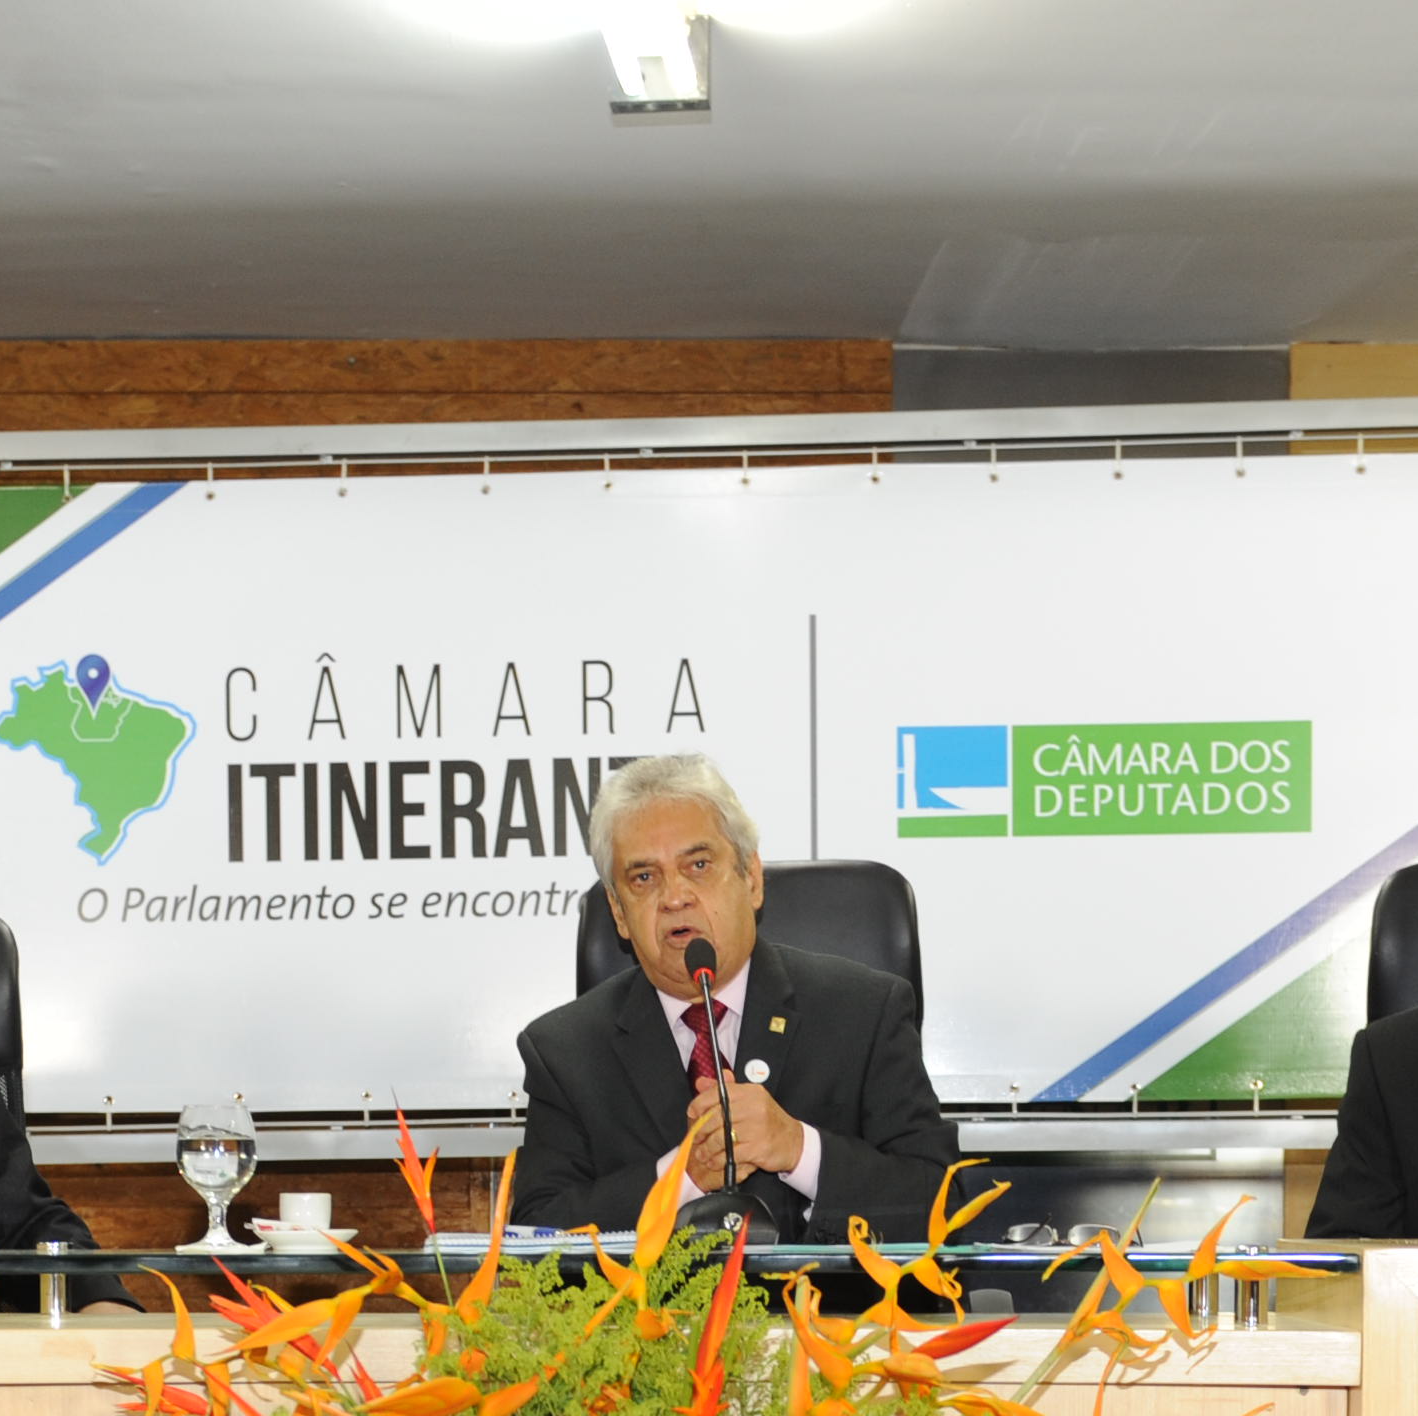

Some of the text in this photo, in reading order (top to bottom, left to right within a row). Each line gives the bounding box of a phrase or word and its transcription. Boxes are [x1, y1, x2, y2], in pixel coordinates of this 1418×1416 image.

[225, 652, 706, 742] CÂMARA
[1032, 734, 1292, 776] CÂMARA DOS
[227, 755, 661, 863] ITINERAN
[1033, 780, 1292, 817] DEPUTADOS
[77, 881, 584, 923] O Parlamento se encontr
